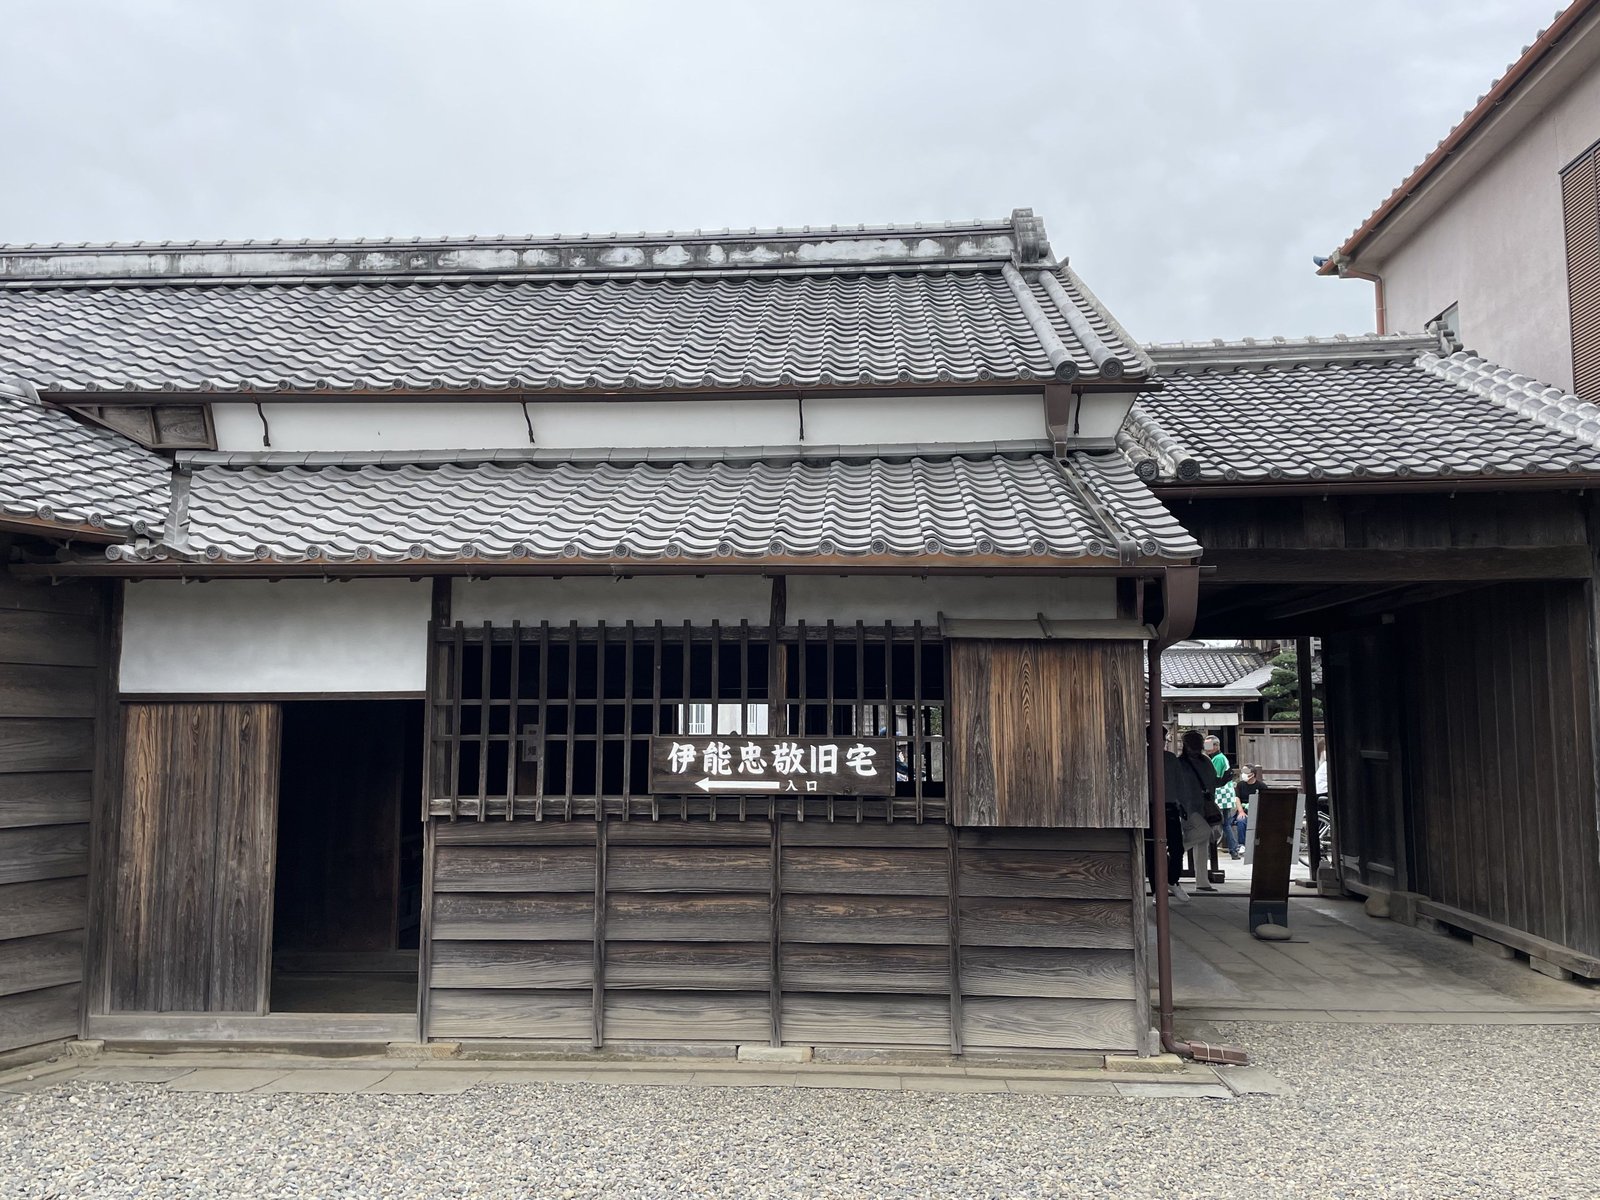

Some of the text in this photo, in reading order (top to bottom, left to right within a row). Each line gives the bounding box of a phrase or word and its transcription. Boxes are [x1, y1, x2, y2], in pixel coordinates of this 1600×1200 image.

[667, 741, 878, 776] 伊能忠敬旧宅
[785, 779, 818, 792] 入口
